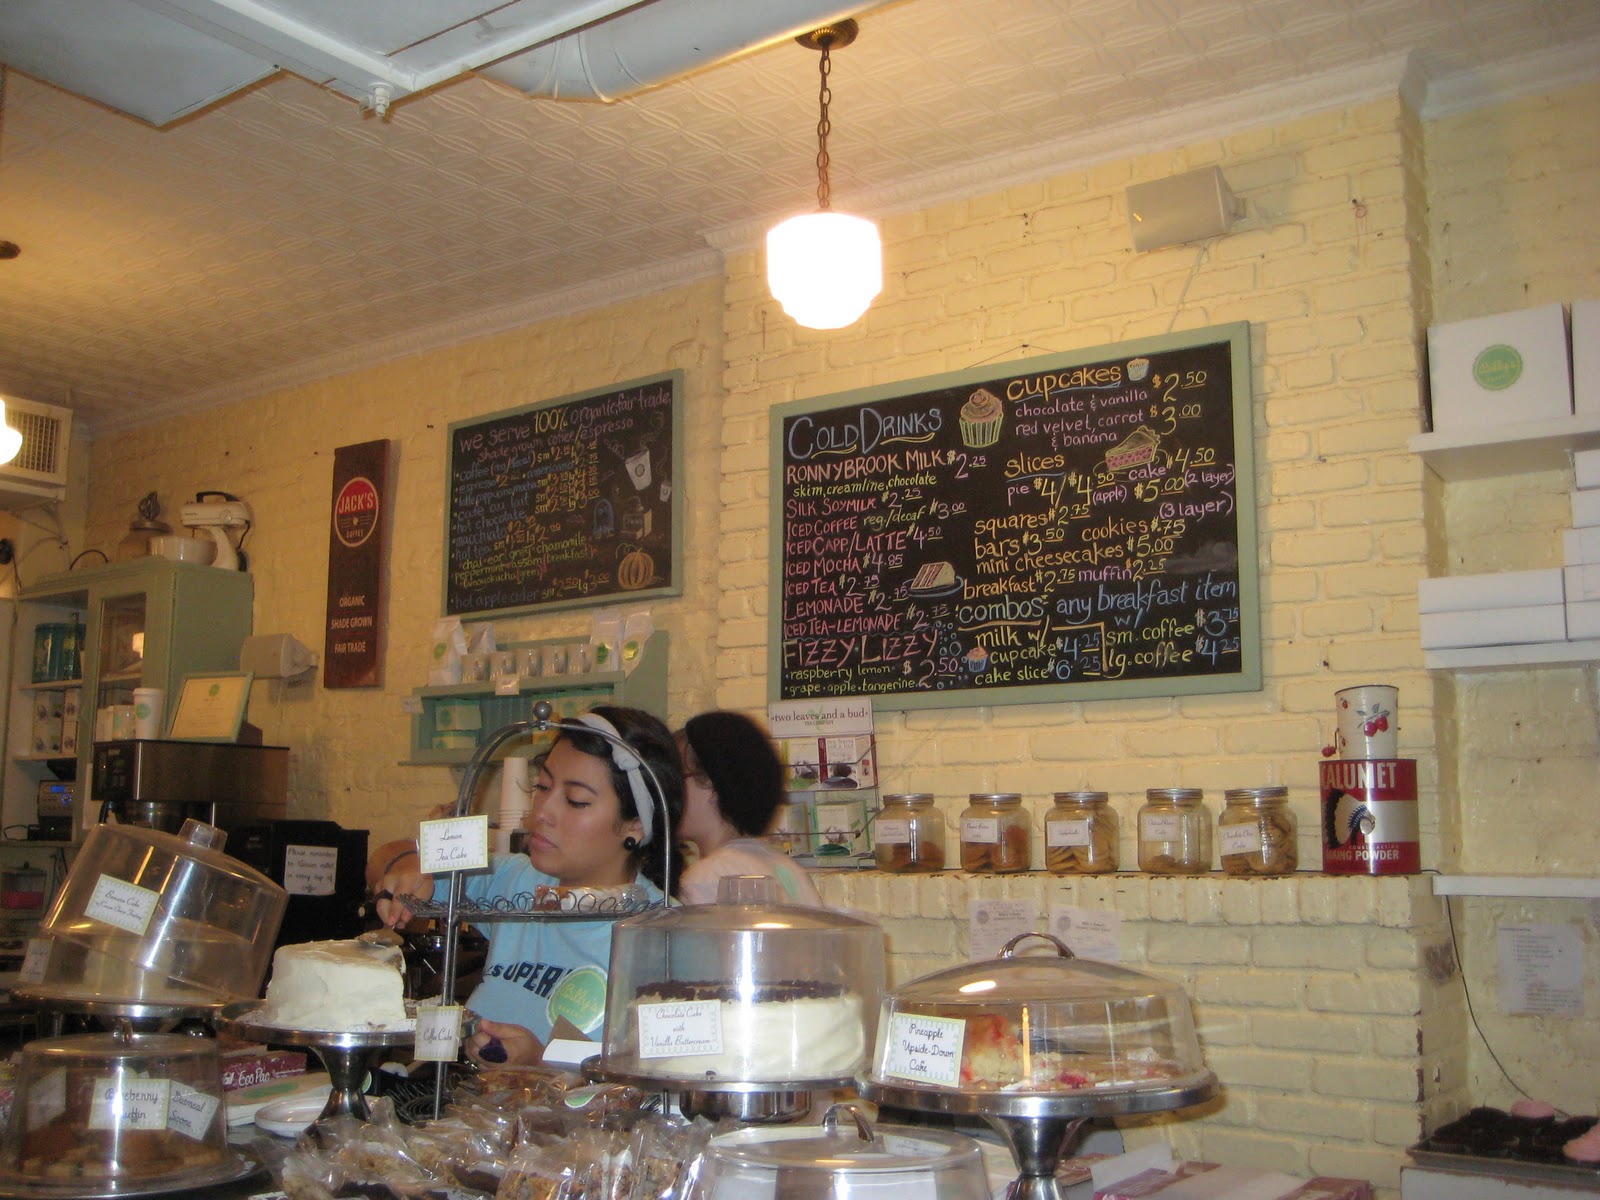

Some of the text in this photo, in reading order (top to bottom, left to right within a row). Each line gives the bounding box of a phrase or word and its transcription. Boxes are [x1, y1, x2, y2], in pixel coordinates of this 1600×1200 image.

[1007, 366, 1121, 401] cupcakes
[1016, 397, 1083, 417] chocolate
[1100, 390, 1147, 407] vanilla
[1153, 371, 1206, 402] $2.50
[488, 426, 530, 446] serve
[534, 407, 568, 434] 100%
[1016, 421, 1037, 435] red
[1099, 409, 1143, 426] carrot
[1150, 405, 1202, 435] $3.00
[479, 446, 510, 462] shade
[510, 437, 544, 459] grown
[1064, 432, 1117, 447] banana
[460, 462, 489, 482] coffee
[787, 450, 986, 484] RONNYBROOK MILK $2.25
[1005, 453, 1065, 477] slices
[1129, 449, 1215, 481] cake $4.50
[1134, 477, 1185, 502] $5.00
[1201, 464, 1235, 487] layer)
[338, 492, 374, 514] JACK'S
[786, 489, 922, 518] SILK SOYMILK $2.25
[1008, 485, 1029, 506] pie
[1093, 485, 1127, 505] (apple)
[1179, 491, 1233, 521] layer)
[476, 510, 527, 529] chocolate
[787, 522, 812, 539] ICED
[814, 516, 857, 535] COFFEE
[929, 499, 966, 519] $3.00
[975, 503, 1091, 537] squares $2.75
[1082, 516, 1148, 542] cookies
[346, 528, 363, 538] COFFEE
[456, 525, 507, 547] macchiato
[786, 541, 812, 558] ICED
[906, 523, 943, 549] $4.50
[975, 528, 1065, 560] bars $3.50
[509, 547, 532, 559] grey
[976, 535, 1174, 574] mini cheesecakes $5.00
[455, 564, 505, 584] peppermint
[511, 558, 541, 568] assam
[785, 553, 903, 578] ICED MOCHA $4.85
[785, 574, 879, 597] ICED TEA $2.75
[964, 558, 1166, 600] breakfast $2.75 muffin $2.25
[339, 595, 365, 607] ORGANIC
[476, 591, 507, 608] apple
[578, 578, 588, 593] lg
[784, 587, 908, 621] LEMONADE $2.75
[1056, 573, 1236, 625] any breakfast item
[331, 616, 372, 629] SHADE GROWN
[784, 621, 806, 639] ICED
[906, 603, 950, 630] $2.75
[1115, 608, 1142, 629] w/
[1142, 618, 1194, 641] coffee
[976, 615, 1050, 648] milk w/
[334, 642, 366, 653] FAIR TRADE
[783, 629, 938, 668] FIZZY LIZZY
[990, 633, 1100, 669] cupcake $4.25
[1135, 642, 1193, 667] coffee
[790, 665, 890, 683] raspberry lemon
[902, 658, 958, 689] $2.50
[975, 656, 1100, 685] cake slice $6.25
[790, 678, 916, 696] grape apple tangerine
[775, 713, 791, 722] two
[793, 711, 820, 720] leaves
[821, 710, 838, 719] and
[847, 708, 865, 718] bud
[1321, 762, 1397, 789] CALUMET
[440, 828, 462, 841] Lemon
[436, 847, 467, 861] Tea Cake
[1355, 850, 1399, 860] POWDER
[656, 1006, 702, 1019] Chocolate Cake
[438, 1028, 452, 1040] Cake
[673, 1022, 685, 1032] with
[909, 1023, 944, 1041] Pineapple
[651, 1035, 710, 1047] Vanilla Buttercream
[902, 1040, 954, 1058] Upside-Down
[909, 1059, 927, 1072] Cake
[105, 1088, 158, 1106] Bueberry
[172, 1090, 205, 1114] Oatmeal
[169, 1110, 193, 1128] Scone
